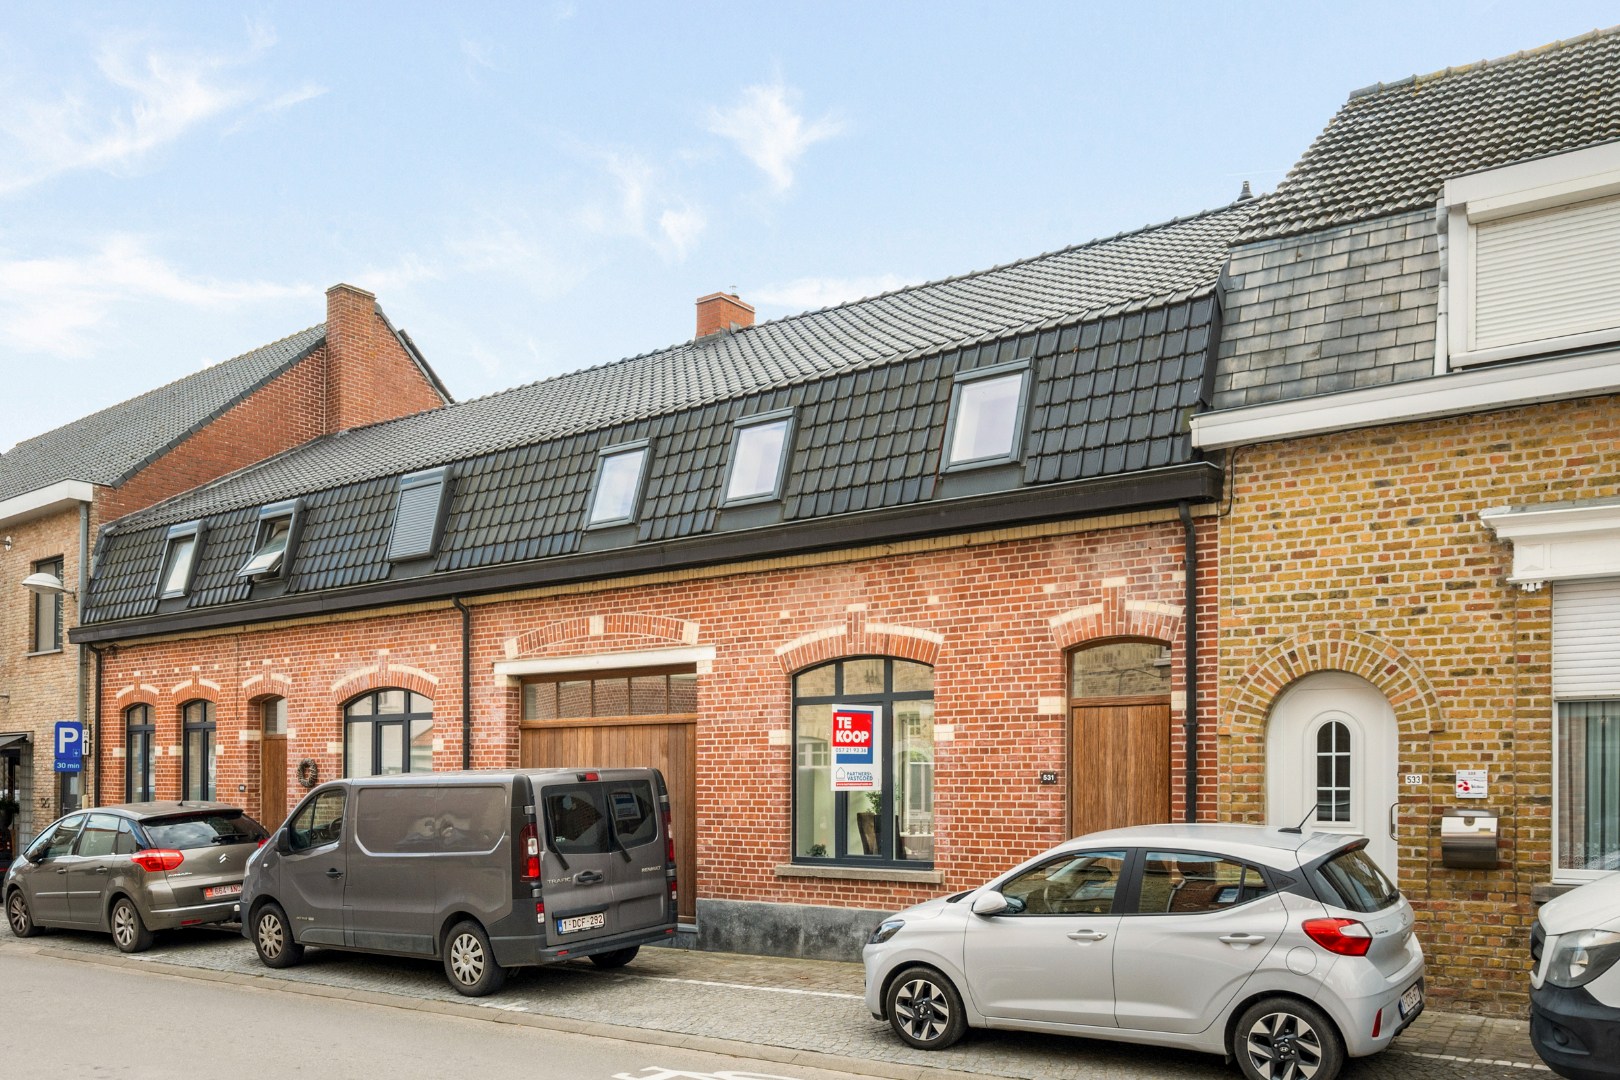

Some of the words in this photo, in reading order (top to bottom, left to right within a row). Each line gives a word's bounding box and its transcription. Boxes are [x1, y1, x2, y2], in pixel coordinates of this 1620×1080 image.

[836, 716, 852, 729] TE
[59, 727, 79, 754] P
[836, 730, 869, 743] KOOP
[1406, 775, 1422, 784] 533
[641, 865, 662, 873] RENAULT
[563, 914, 603, 929] 1-DCF-292
